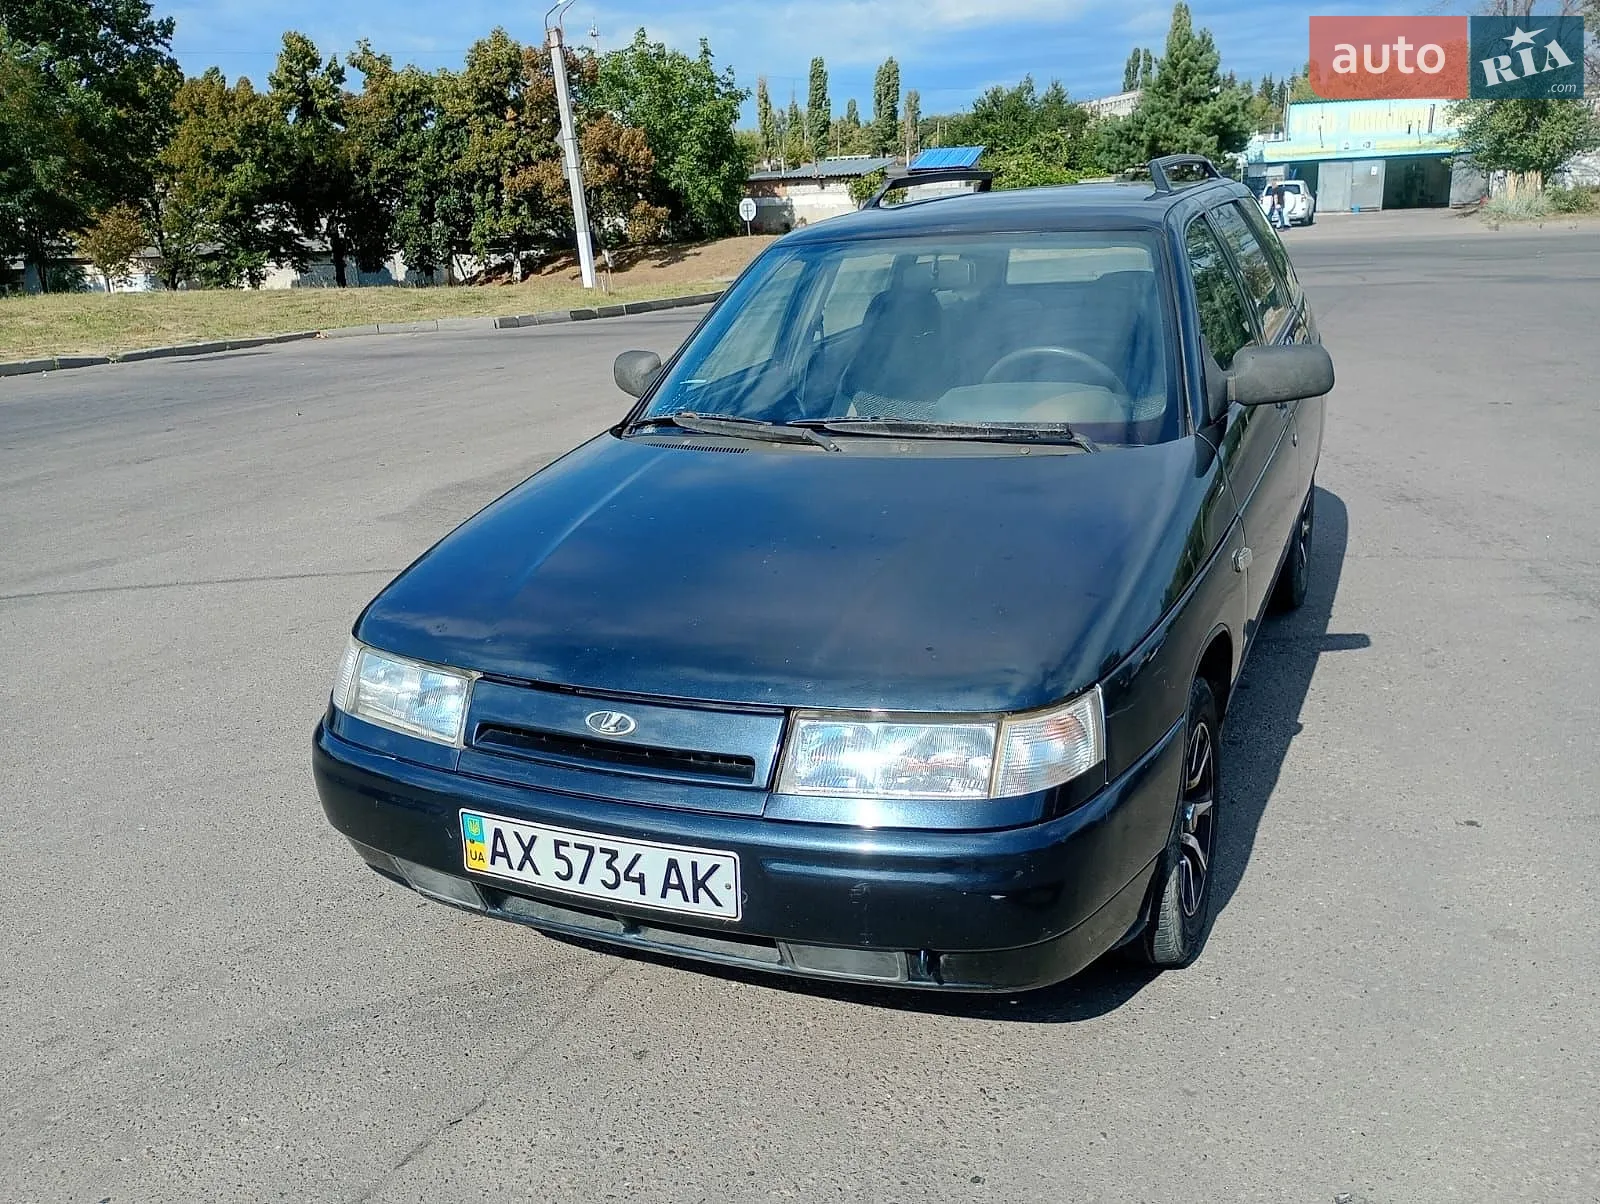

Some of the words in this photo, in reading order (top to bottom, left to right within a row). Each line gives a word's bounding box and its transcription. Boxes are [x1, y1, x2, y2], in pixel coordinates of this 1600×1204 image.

[470, 850, 485, 863] UA
[490, 827, 541, 876] AX
[553, 839, 646, 895] 5734
[660, 857, 723, 907] AK
